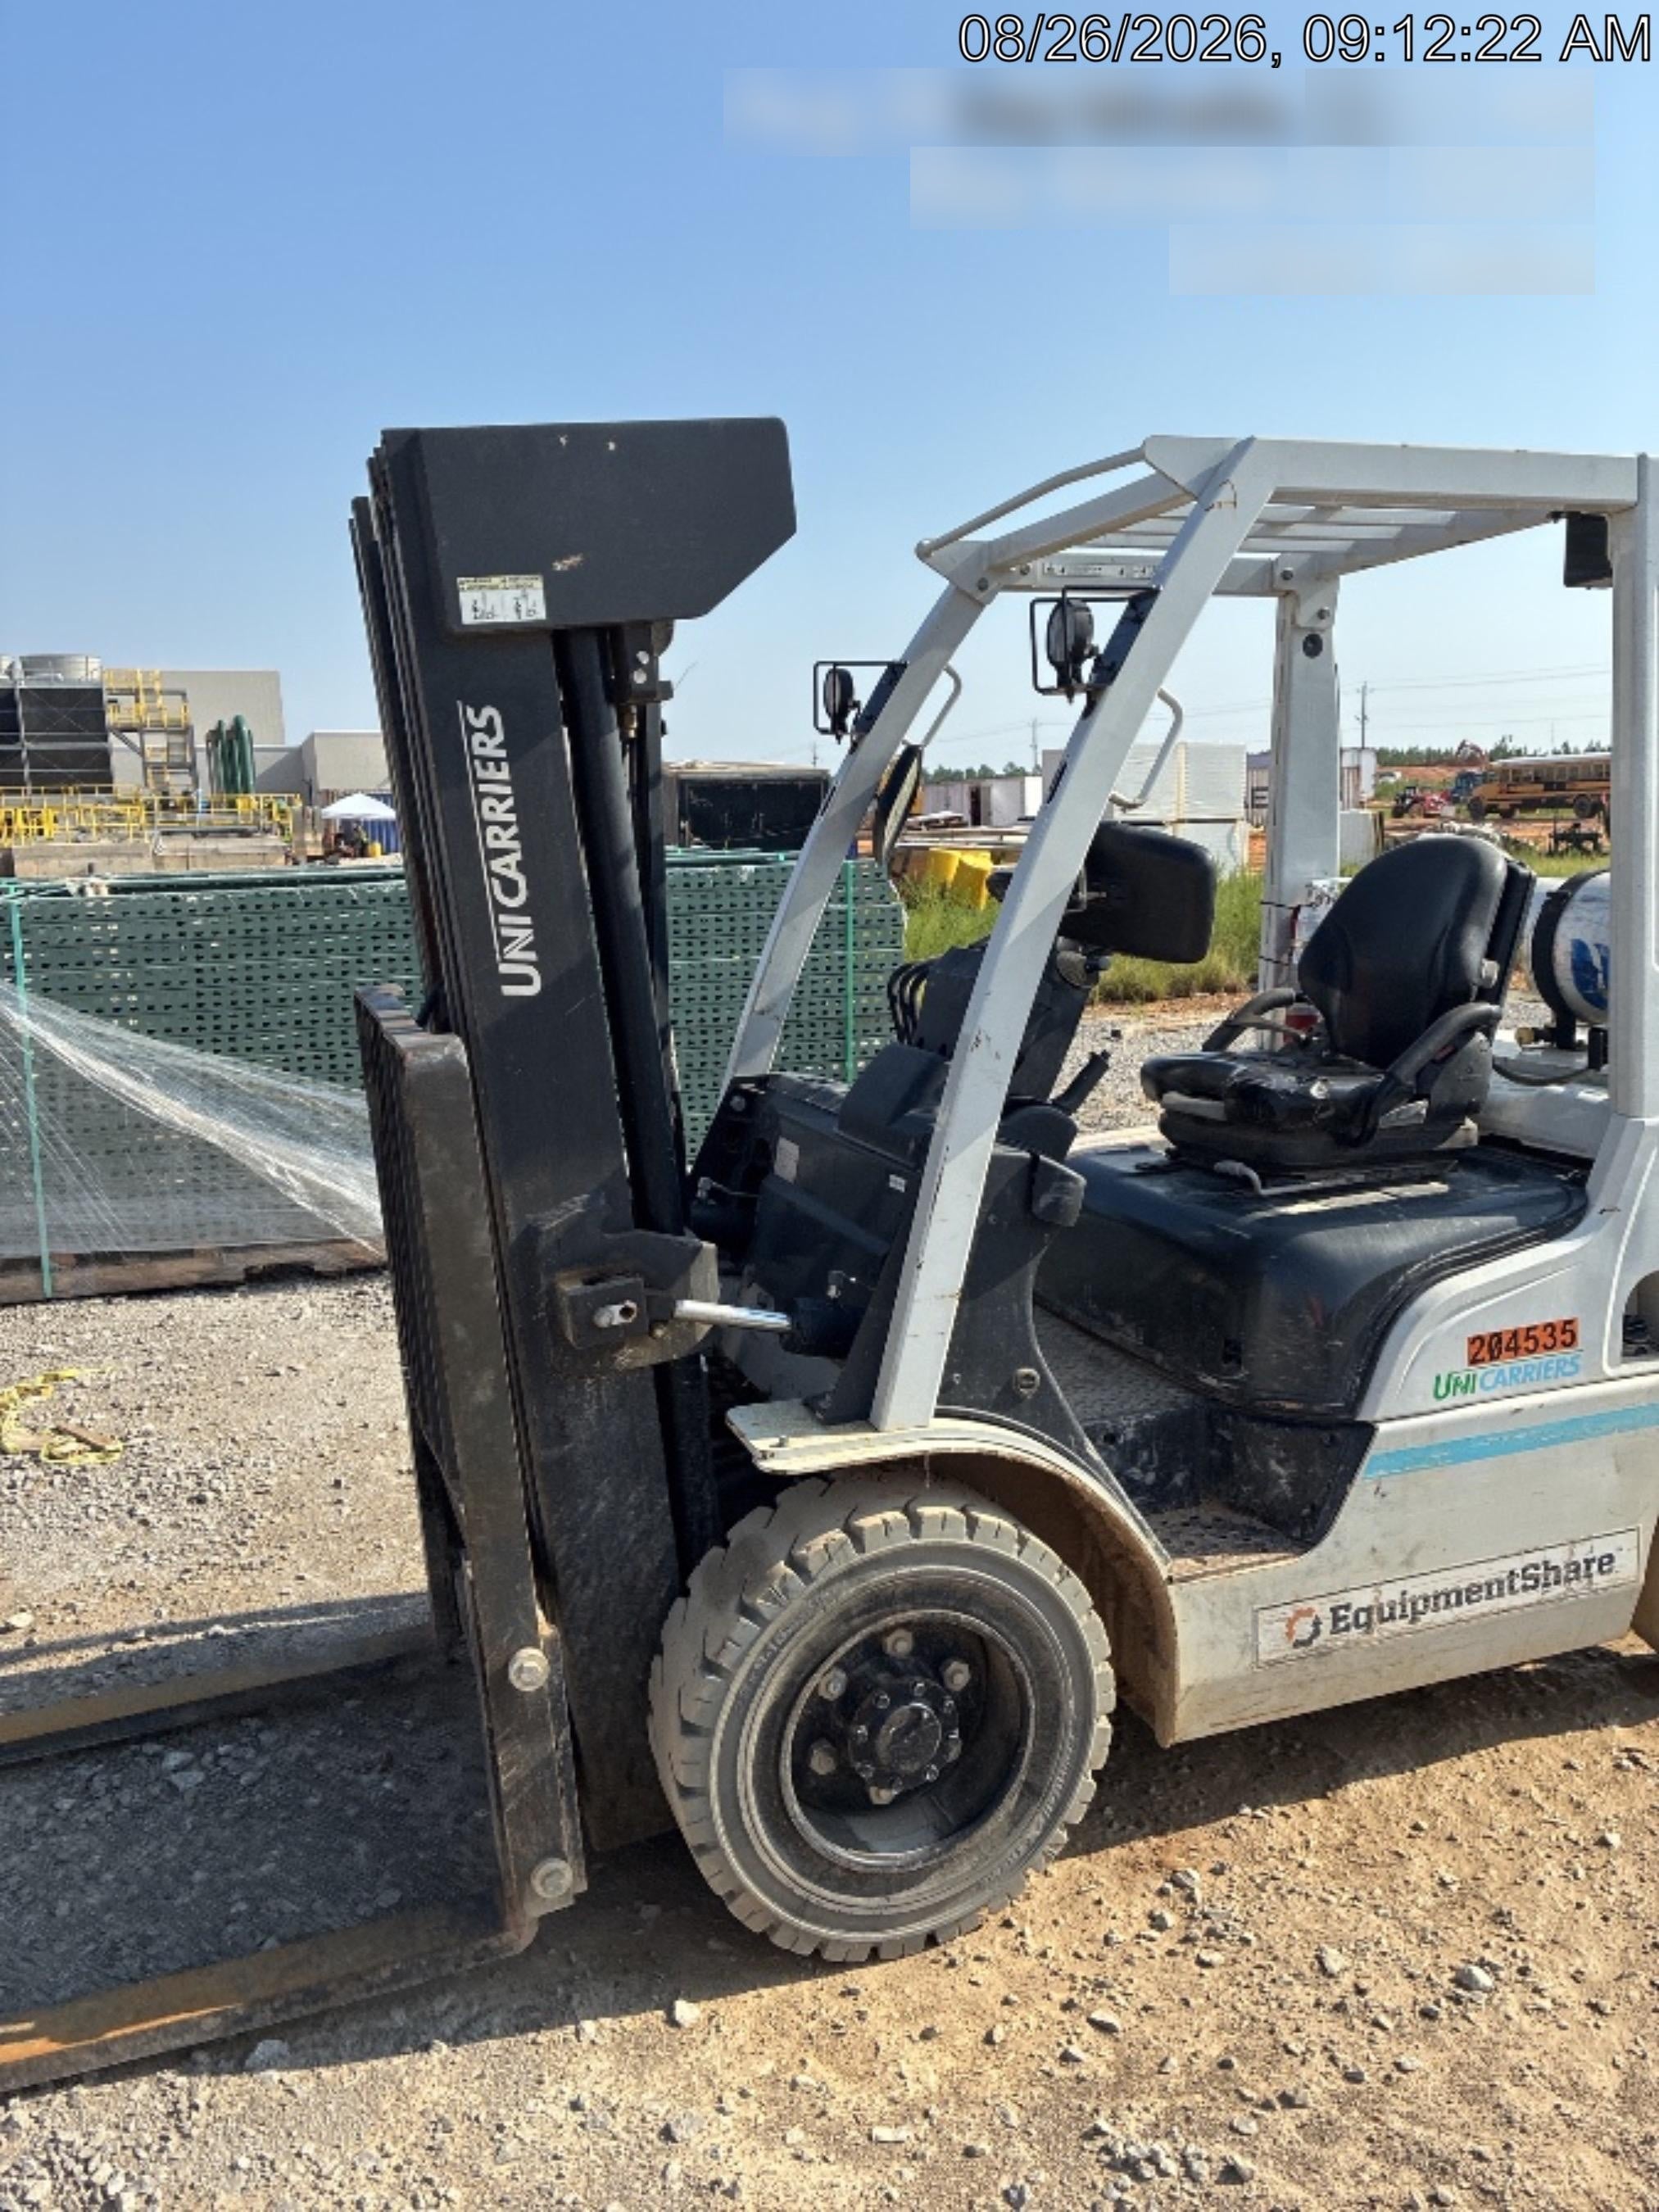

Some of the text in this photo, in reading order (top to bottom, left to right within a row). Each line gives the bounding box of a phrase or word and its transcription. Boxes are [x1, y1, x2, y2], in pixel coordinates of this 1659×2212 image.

[465, 704, 542, 997] UNICARRIERS
[1468, 1318, 1577, 1367] 204535
[1329, 1551, 1616, 1637] EquipmentShare
